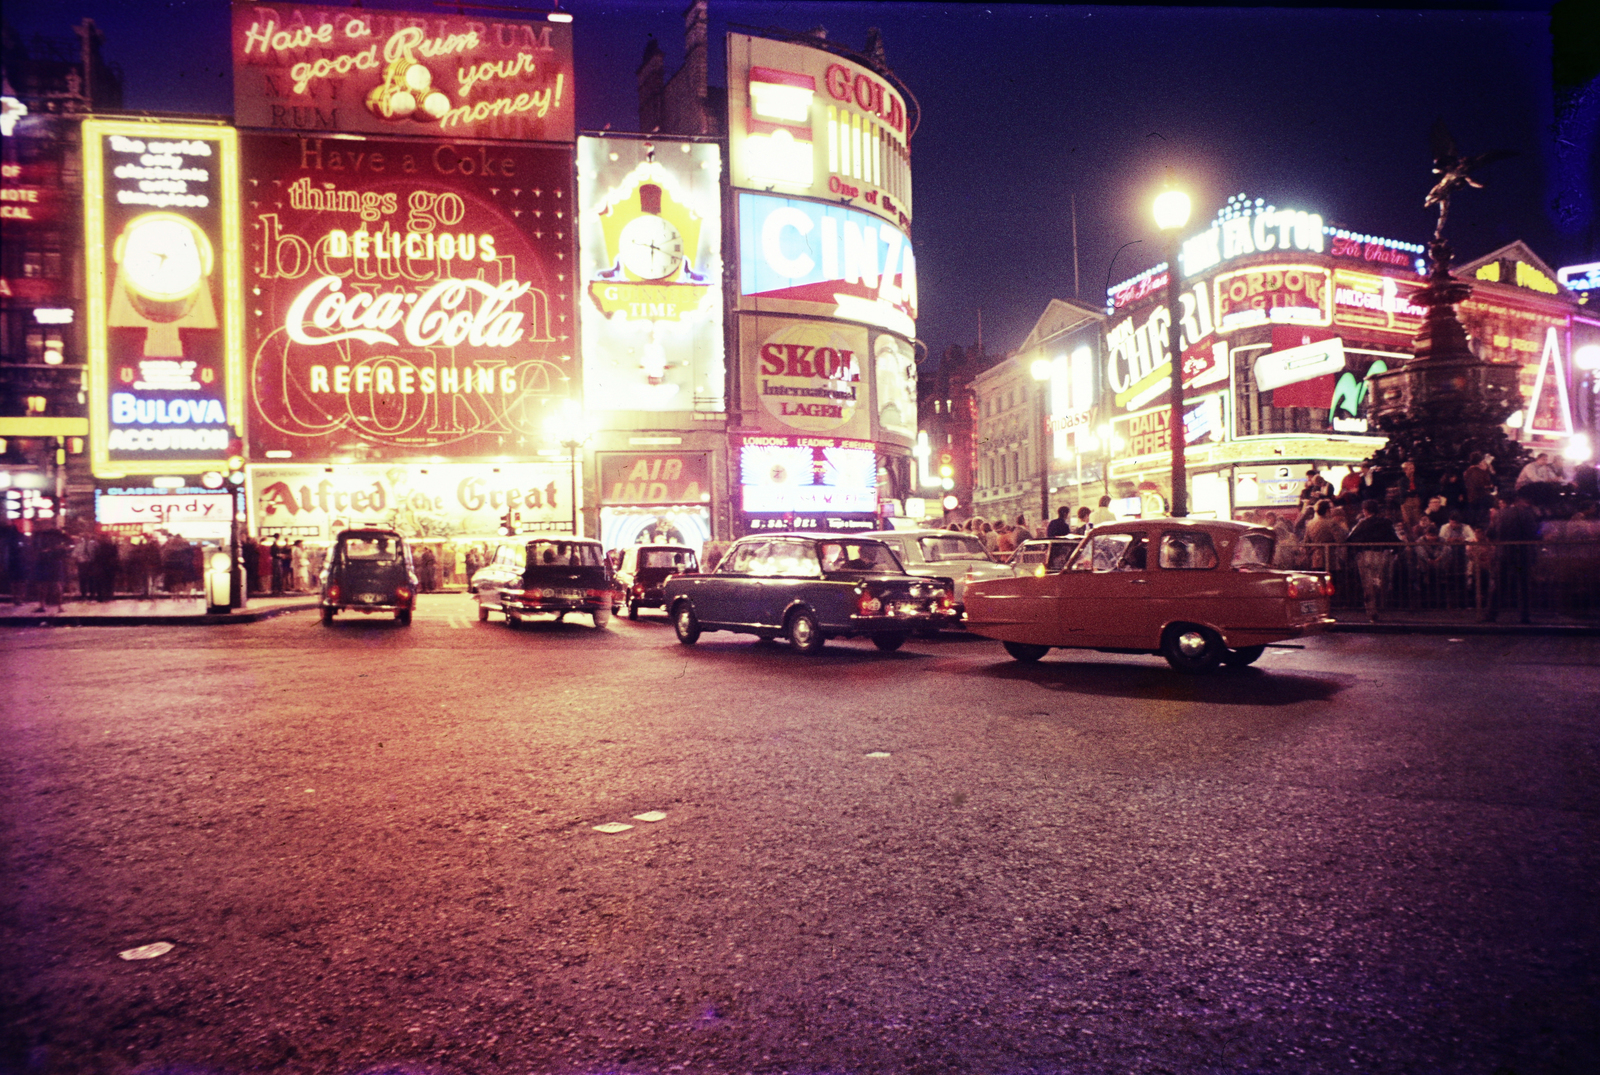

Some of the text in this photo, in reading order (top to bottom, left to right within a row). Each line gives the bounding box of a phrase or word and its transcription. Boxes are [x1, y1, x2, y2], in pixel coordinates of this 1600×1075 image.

[245, 19, 371, 53] Have a
[290, 45, 379, 94] good
[384, 27, 479, 64] Rum
[458, 52, 535, 97] your
[439, 74, 564, 128] money!
[825, 63, 904, 134] GOLD
[300, 138, 517, 177] Have a Coke
[829, 176, 859, 198] One
[288, 177, 465, 234] things go
[330, 229, 497, 263] DELICIOUS
[285, 275, 532, 347] Coca-Cola
[628, 302, 678, 317] TIME
[1251, 293, 1297, 310] GIN
[310, 364, 517, 394] REFRESHING
[760, 342, 860, 382] SKOL
[780, 402, 843, 419] LAGER
[1129, 410, 1171, 436] DAILY
[628, 458, 683, 481] AIR
[131, 499, 215, 516] andy
[260, 480, 387, 516] Alfred
[456, 475, 558, 512] Great
[610, 481, 701, 501] INDA
